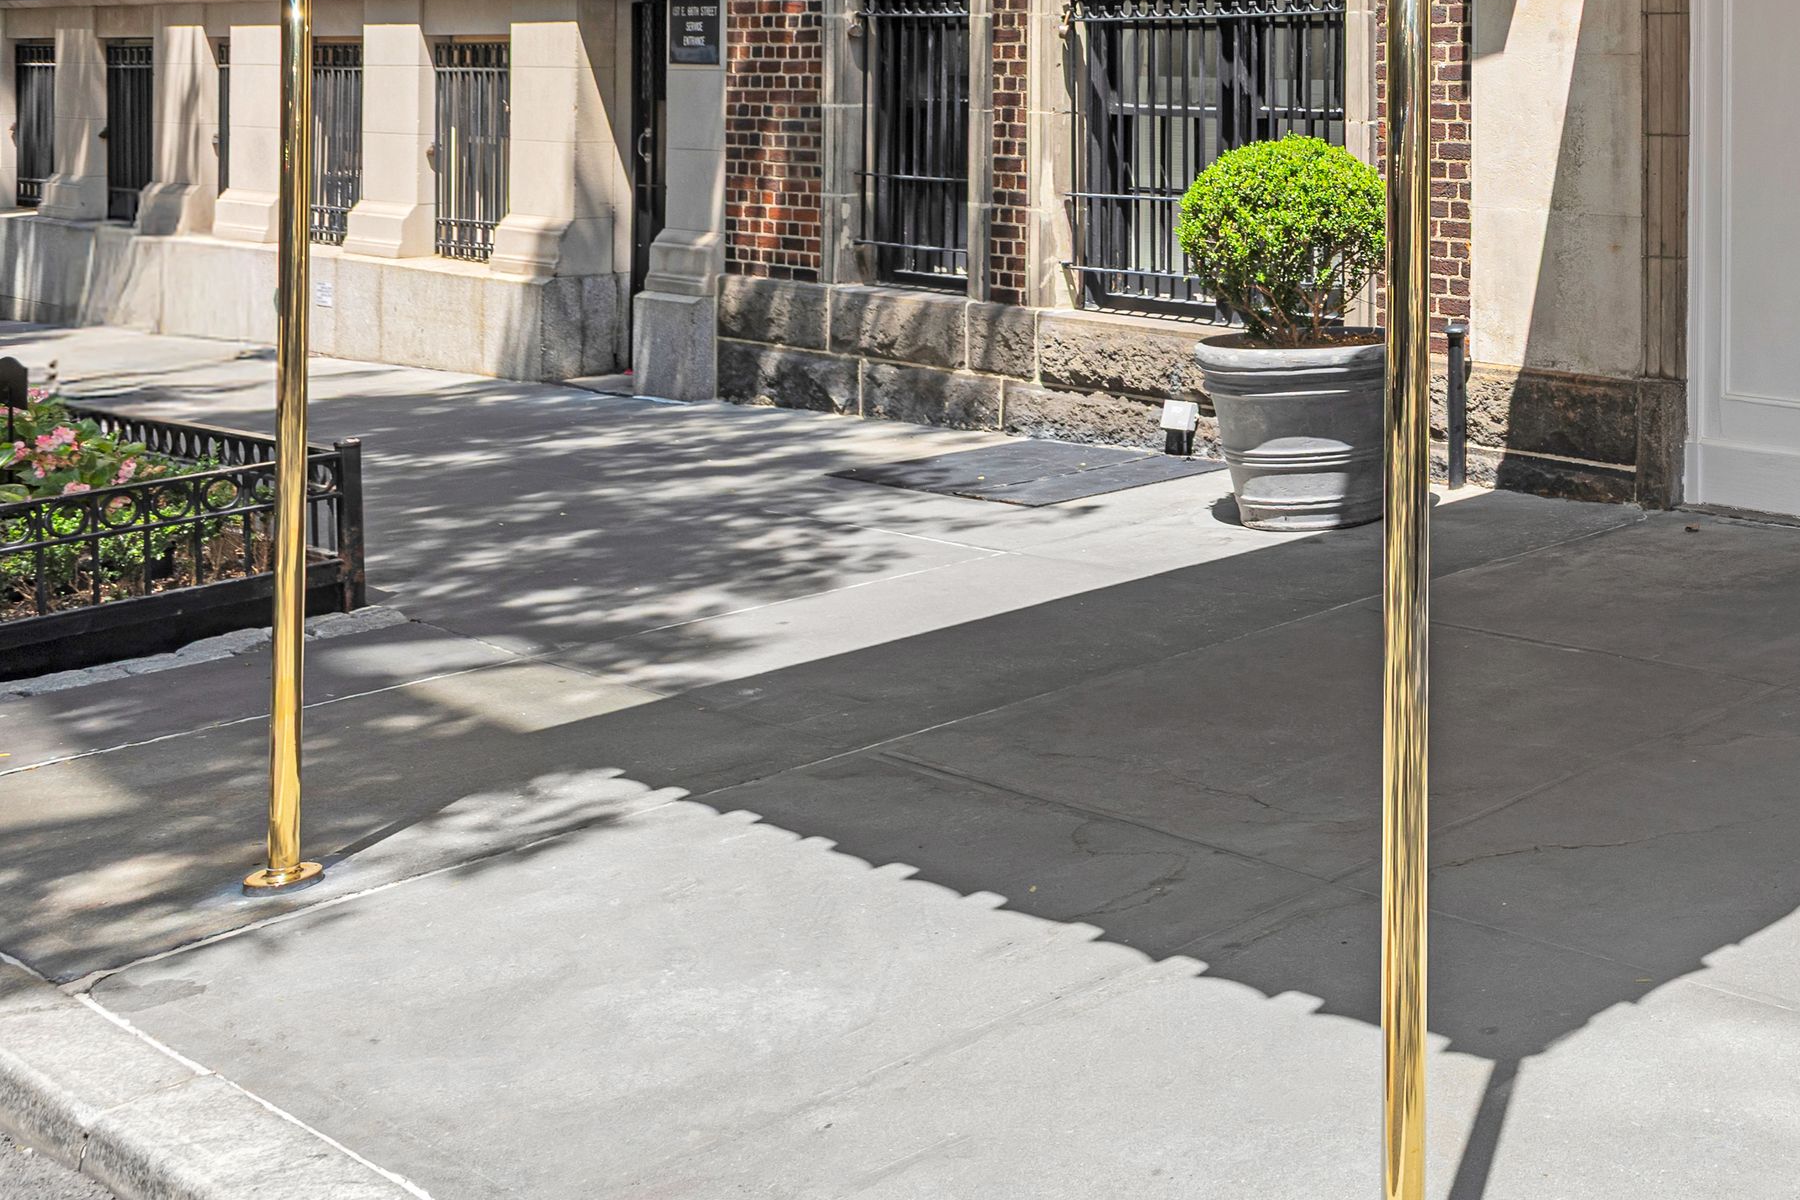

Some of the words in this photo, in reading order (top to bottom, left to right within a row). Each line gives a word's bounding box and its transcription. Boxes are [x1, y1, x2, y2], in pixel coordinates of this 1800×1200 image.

[700, 6, 718, 16] STREET
[685, 21, 704, 32] SERVICE
[683, 35, 705, 46] ENTRANCE
